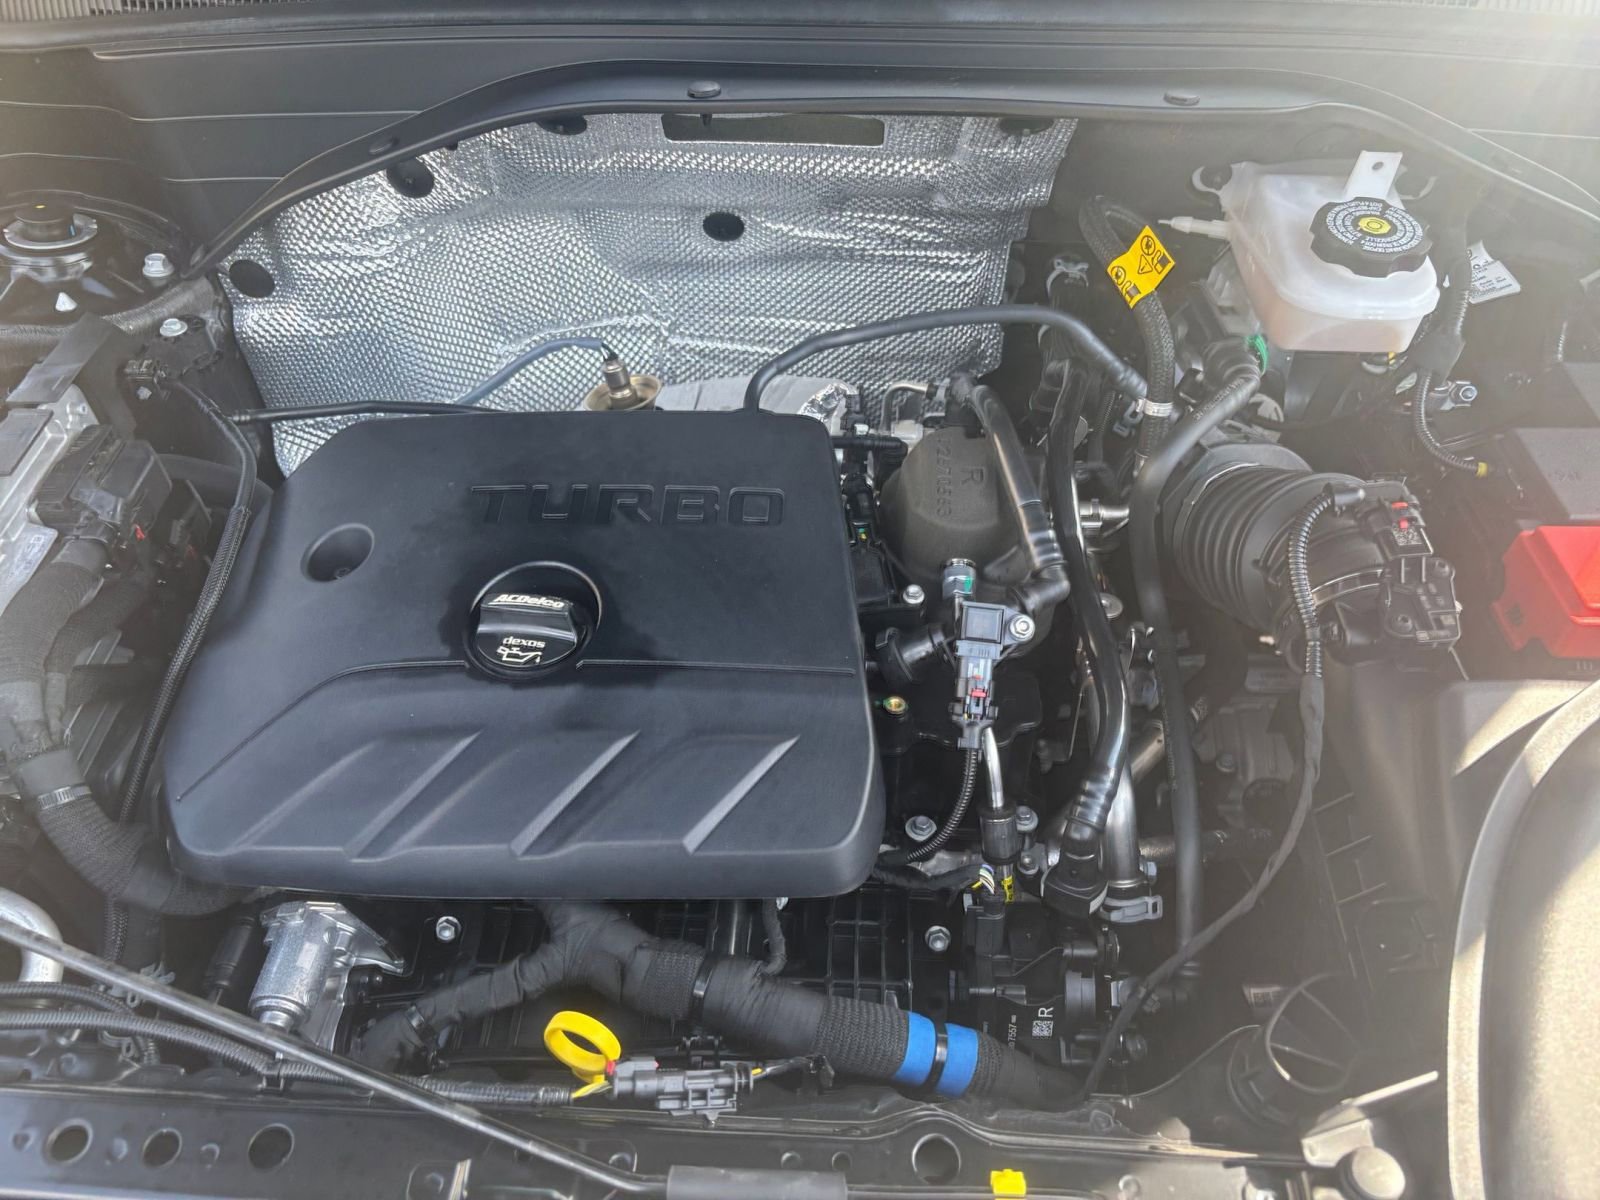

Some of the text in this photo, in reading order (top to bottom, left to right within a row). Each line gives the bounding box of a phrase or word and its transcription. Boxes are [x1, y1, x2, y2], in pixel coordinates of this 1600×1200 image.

[960, 466, 985, 486] R
[470, 483, 785, 527] TURBO
[488, 593, 565, 608] ACDelco
[502, 635, 546, 649] dexos
[1038, 1006, 1054, 1018] R
